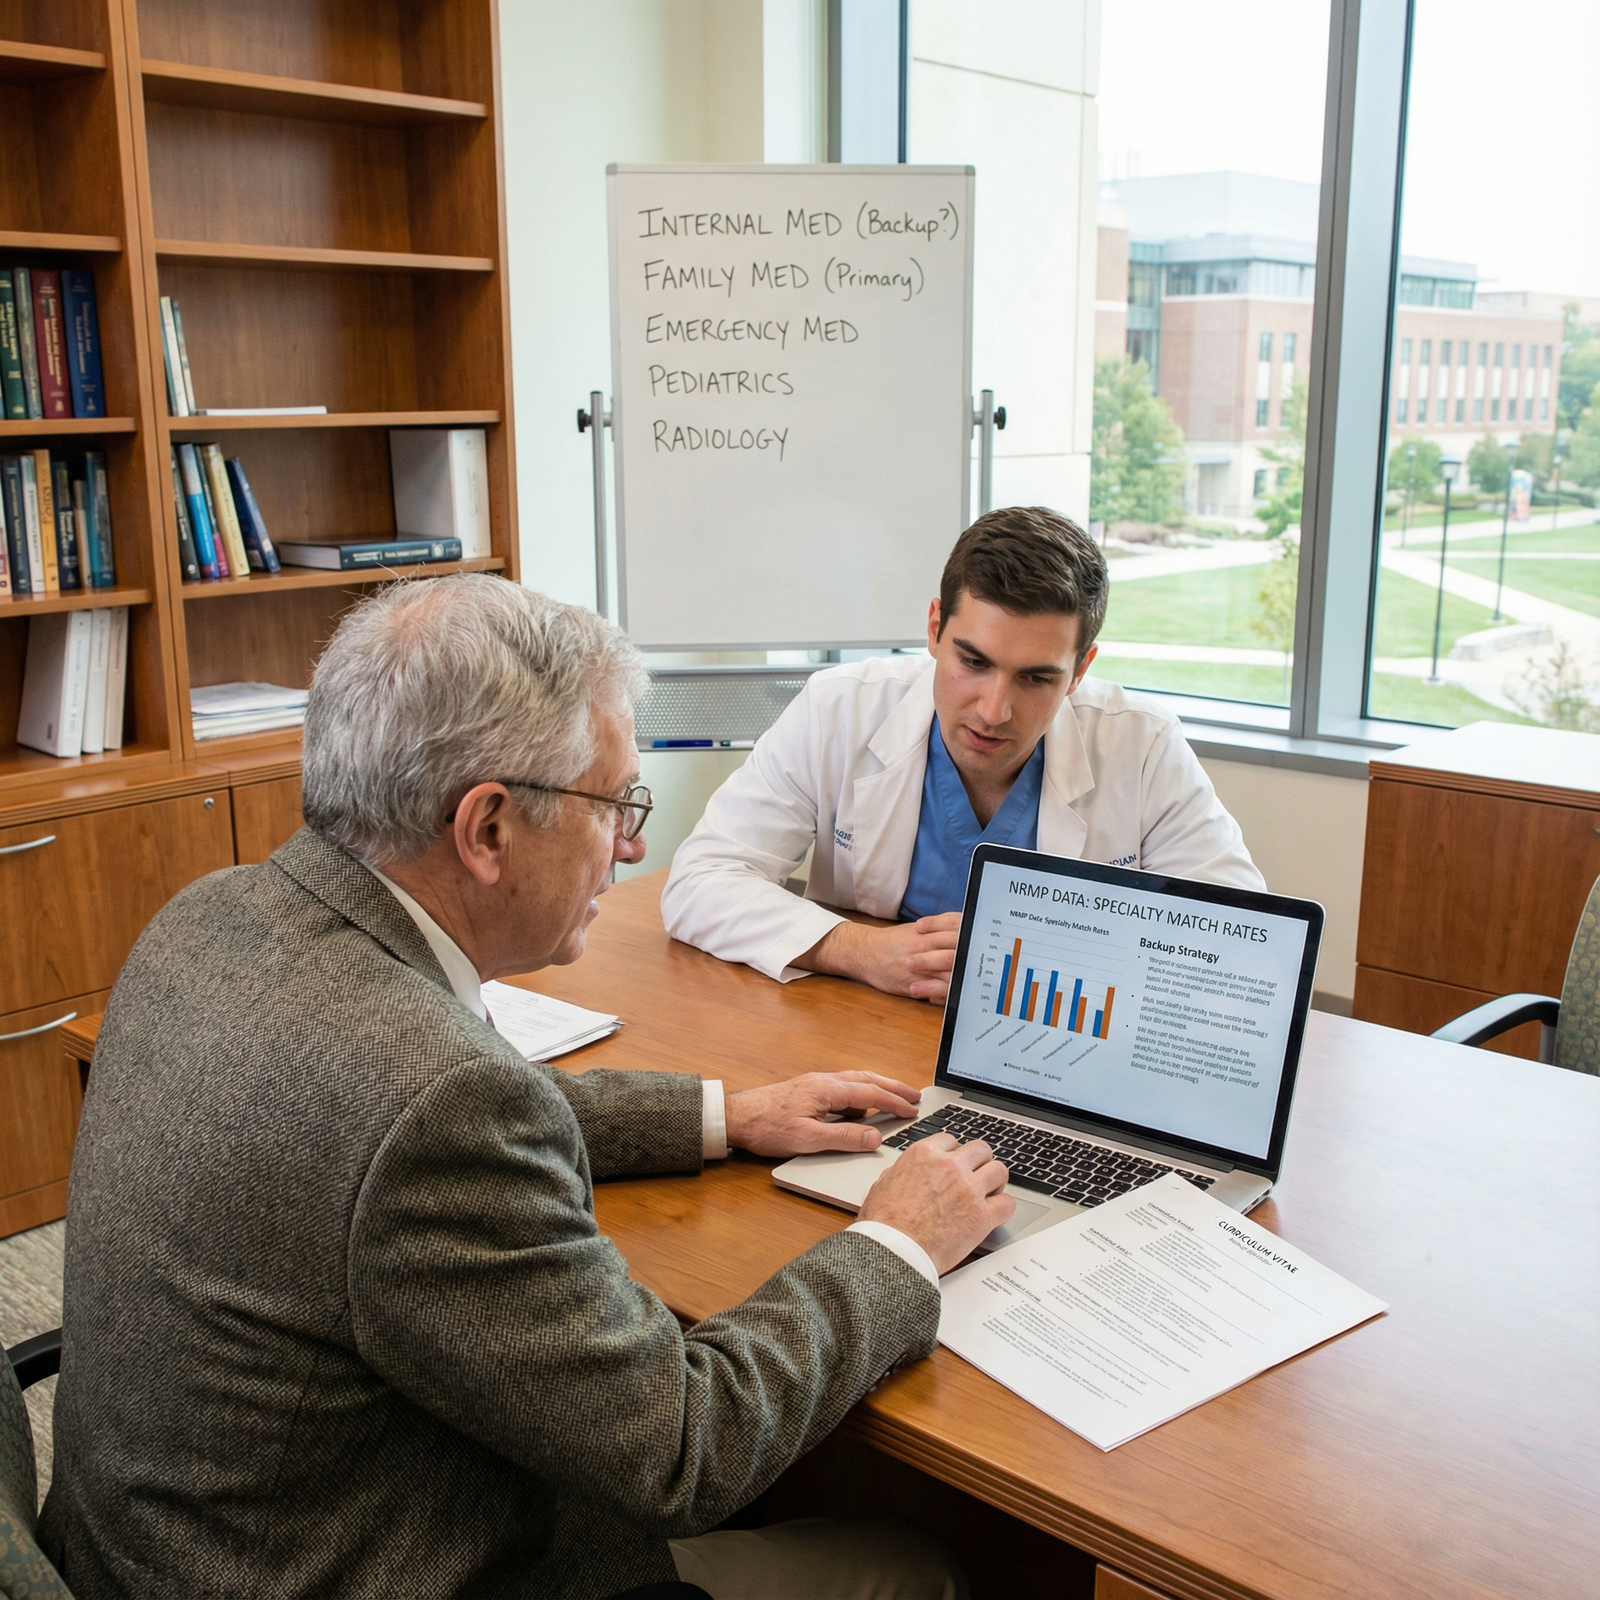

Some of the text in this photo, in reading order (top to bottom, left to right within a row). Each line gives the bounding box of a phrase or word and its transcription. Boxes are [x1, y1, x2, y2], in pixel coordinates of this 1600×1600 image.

[638, 201, 959, 242] INTERNAL MED (Backup?)
[644, 257, 924, 301] FAMILY MED (Primary)
[646, 313, 859, 350] EMERGENCY MED
[649, 364, 794, 397] PEDIATRICS
[653, 420, 788, 462] RADIOLOGY
[1009, 880, 1268, 943] NRMP DATA: SPECIALTY MATCH RATES
[1139, 936, 1220, 964] Backup Strategy
[1272, 1253, 1299, 1274] VITAE
